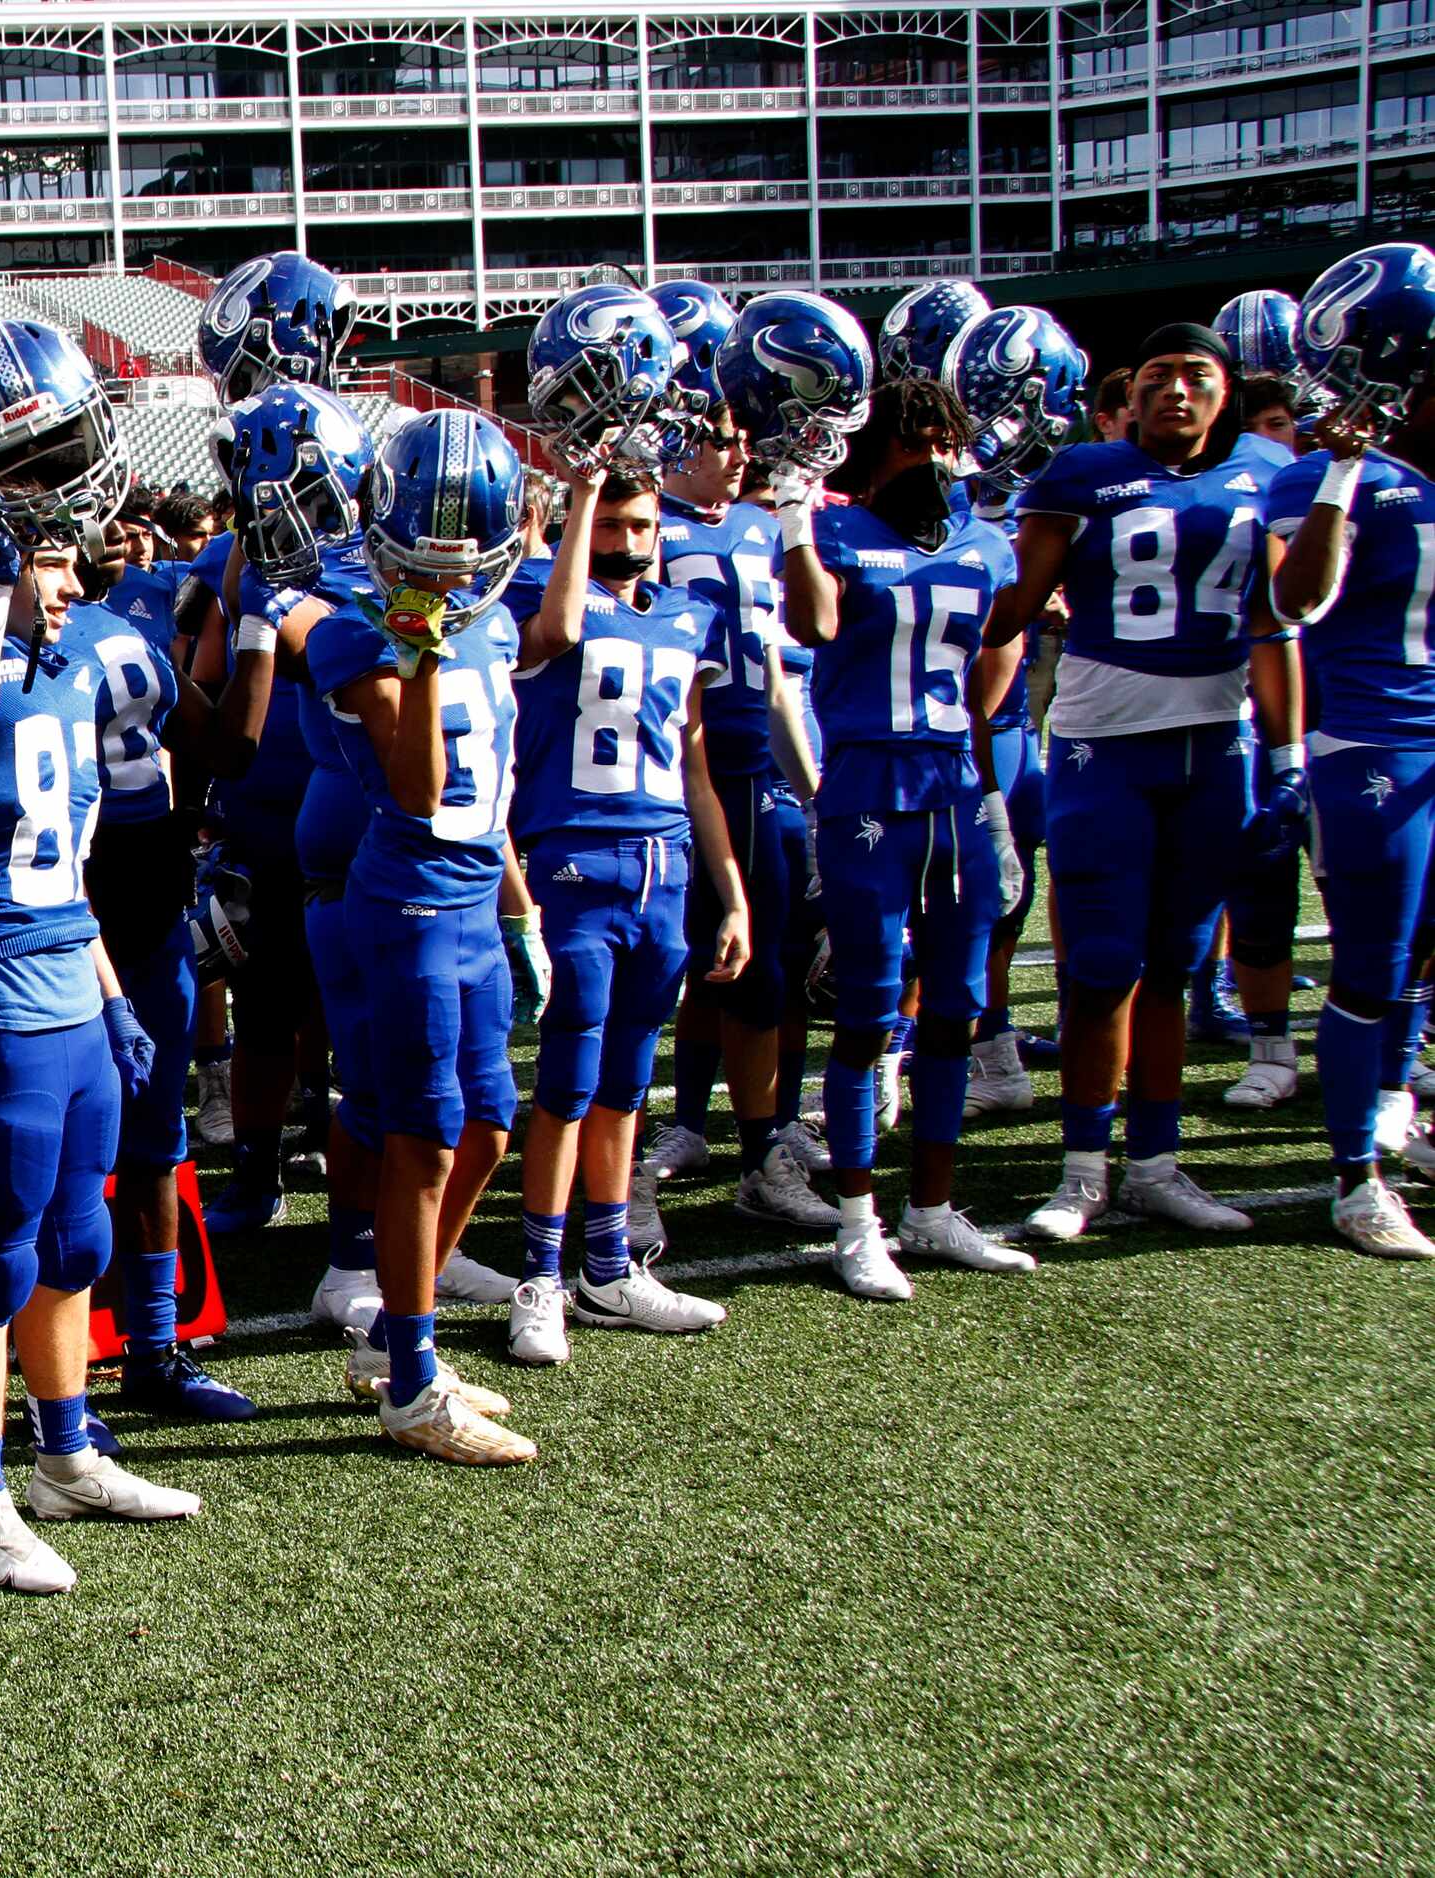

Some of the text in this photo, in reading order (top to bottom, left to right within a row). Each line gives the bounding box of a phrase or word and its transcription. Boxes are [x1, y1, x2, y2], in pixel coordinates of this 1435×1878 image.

[3, 399, 40, 423] Riddell
[1111, 506, 1256, 642] 84
[888, 584, 980, 733] 15
